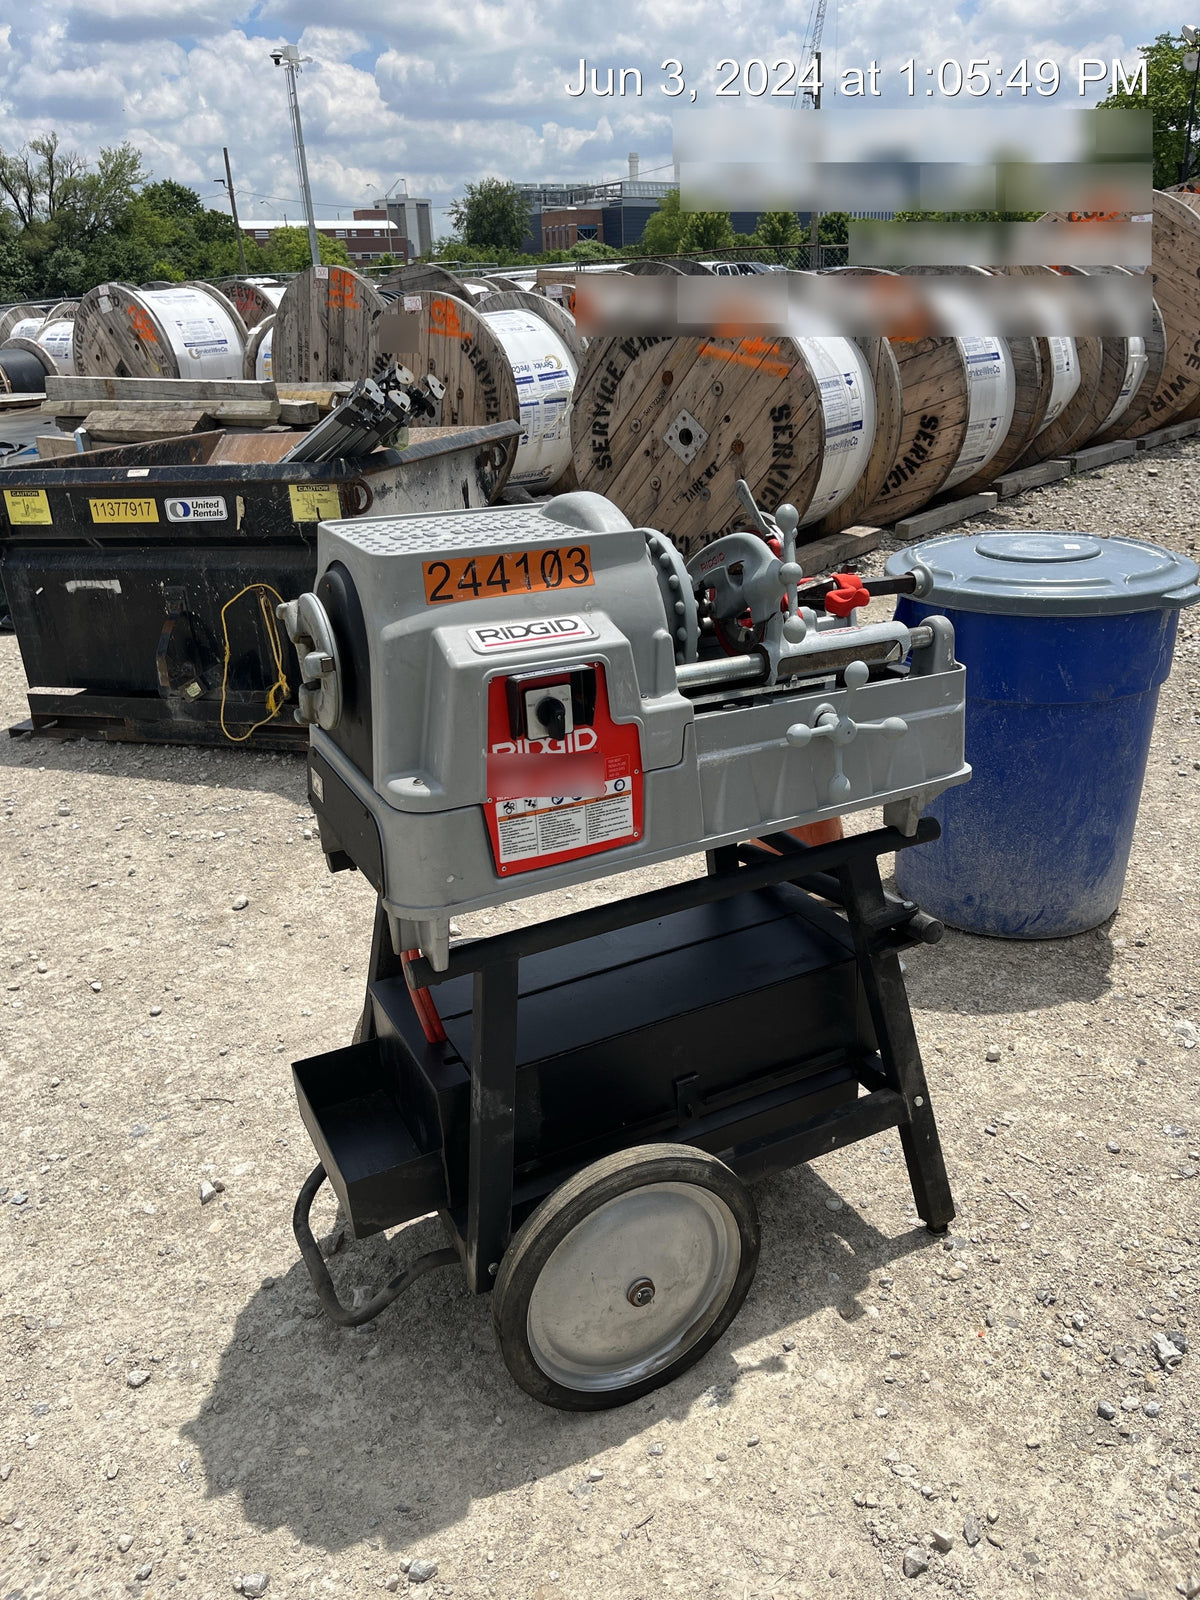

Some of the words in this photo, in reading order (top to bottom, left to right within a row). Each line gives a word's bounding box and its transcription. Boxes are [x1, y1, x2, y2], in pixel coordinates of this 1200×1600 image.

[592, 361, 624, 471] SERVICE
[682, 480, 708, 502] TARE
[93, 501, 151, 518] 11377917
[191, 500, 220, 510] United
[193, 509, 224, 519] Rentals
[427, 546, 590, 602] 244103
[476, 618, 579, 641] RIDGID
